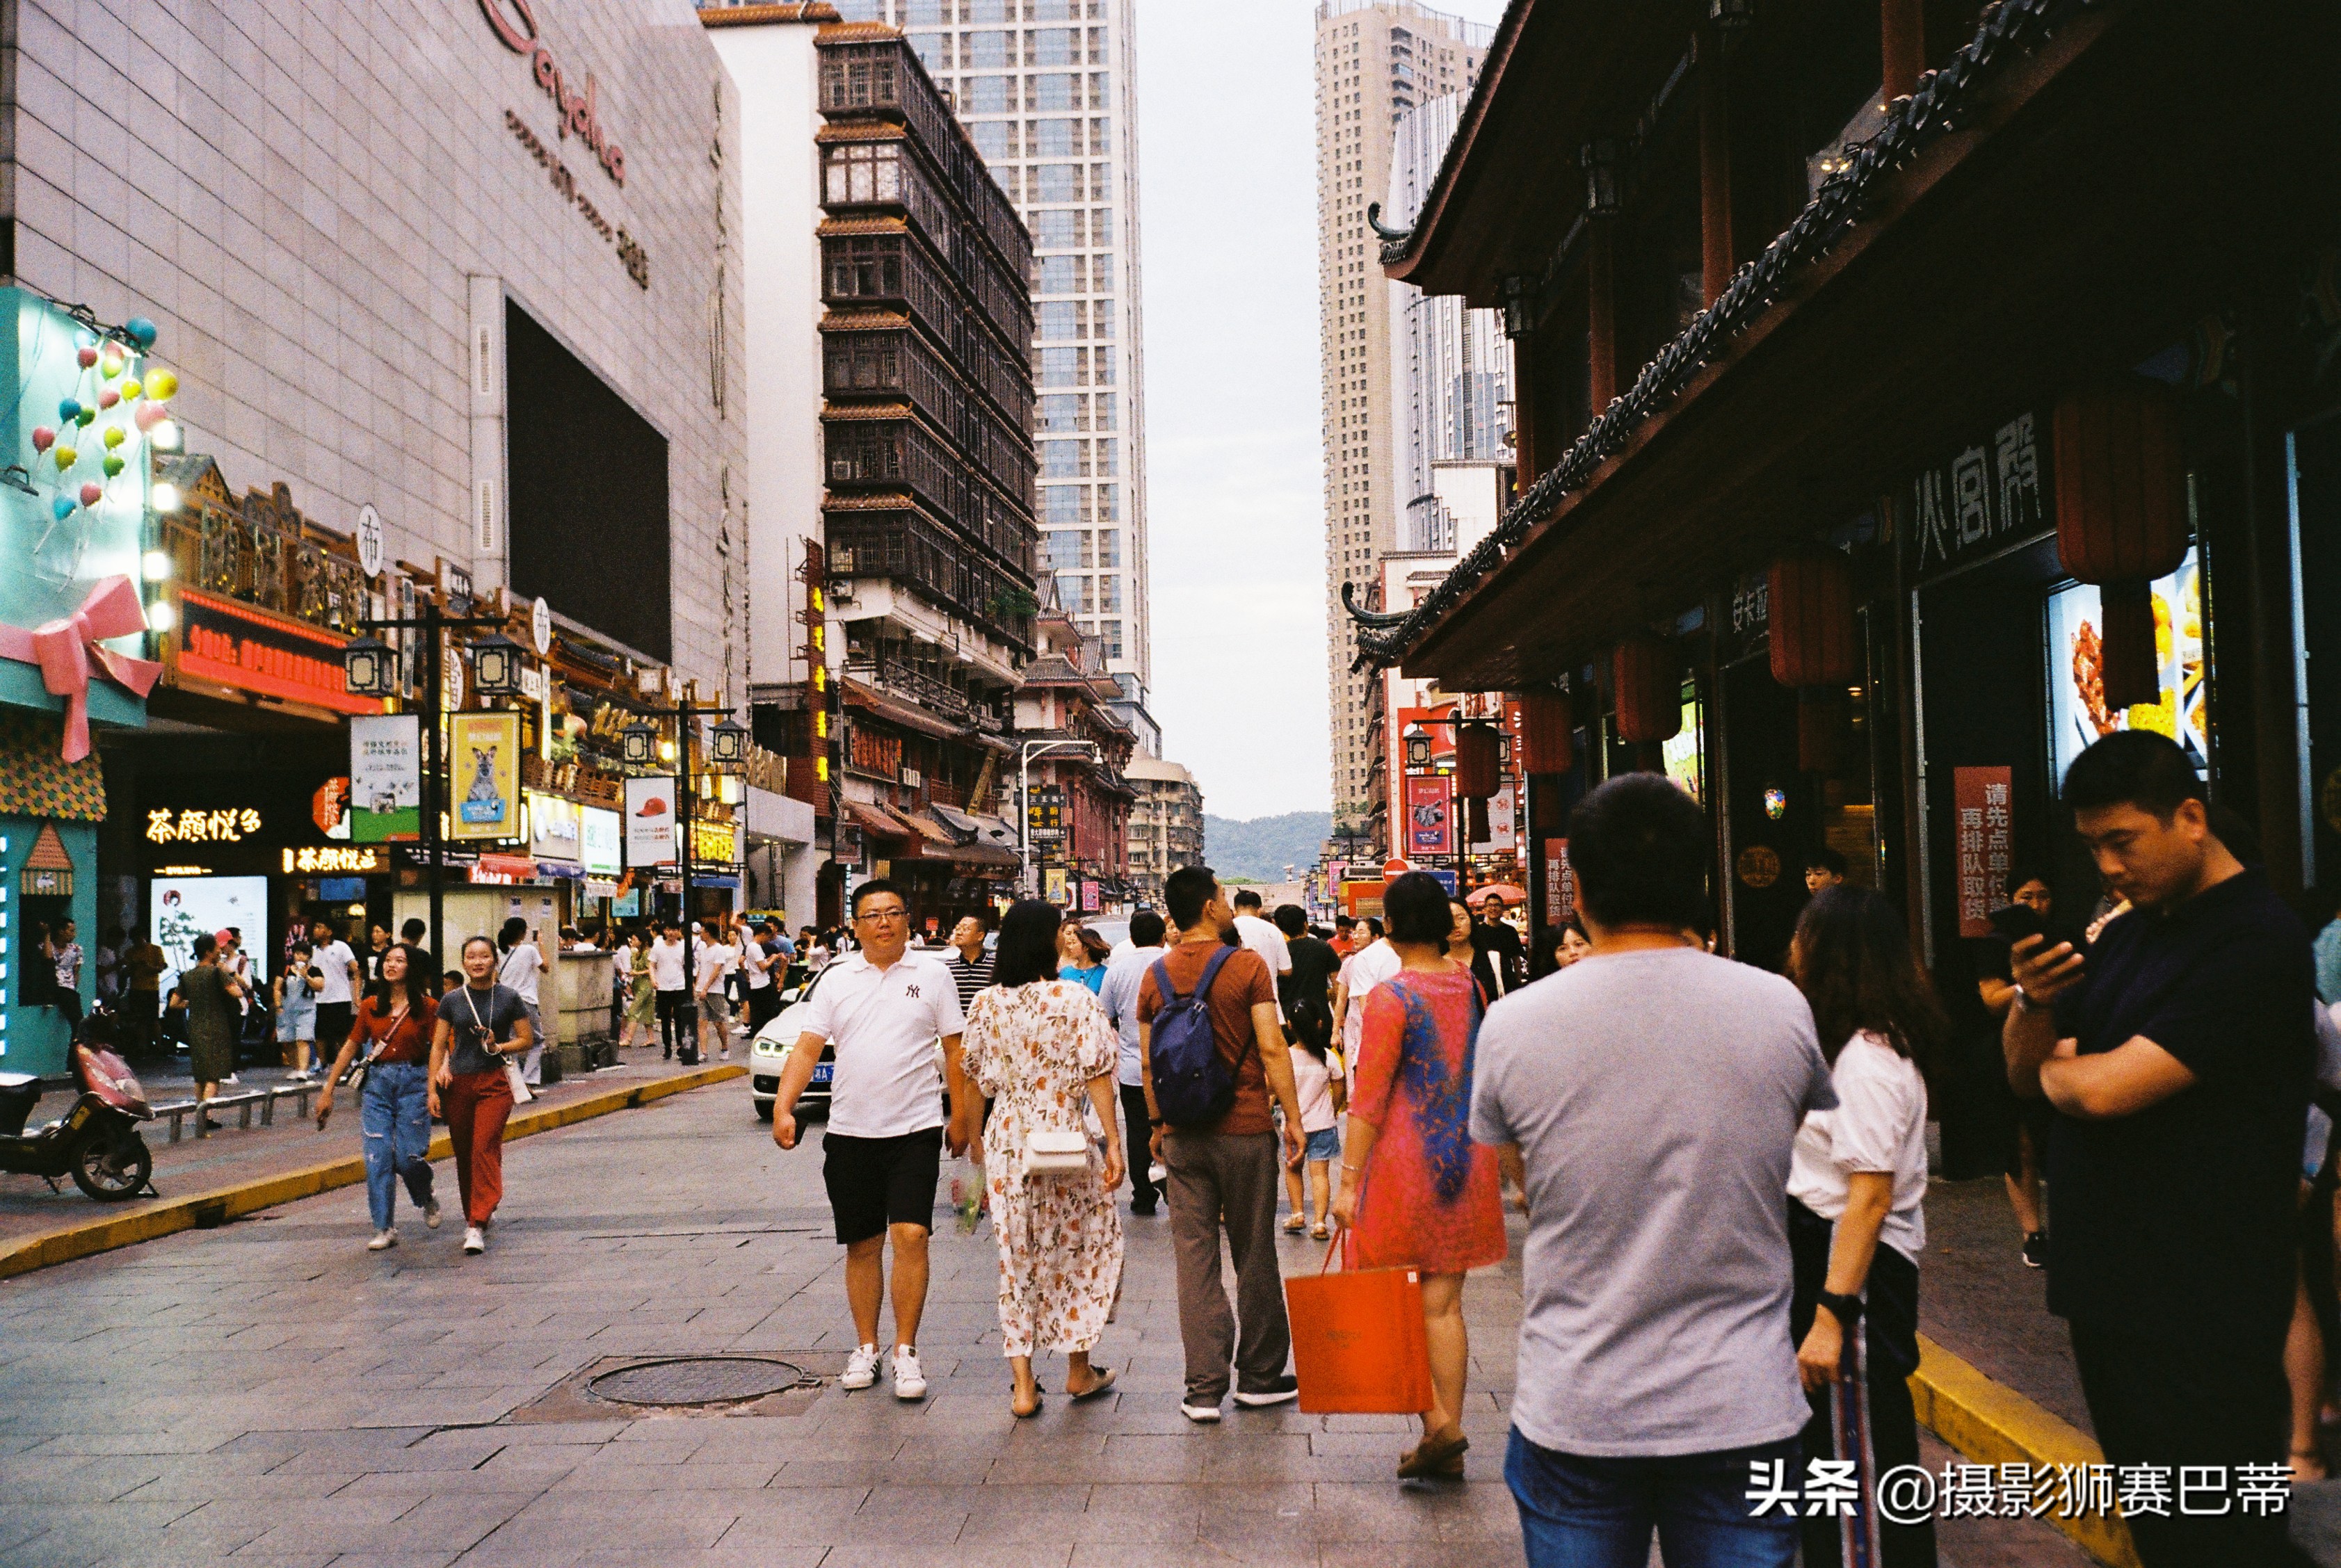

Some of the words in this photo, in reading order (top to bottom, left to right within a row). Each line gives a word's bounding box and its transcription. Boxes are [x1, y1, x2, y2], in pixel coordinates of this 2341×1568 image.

[1961, 808, 1986, 920] 再排队取货
[906, 984, 920, 999] NY
